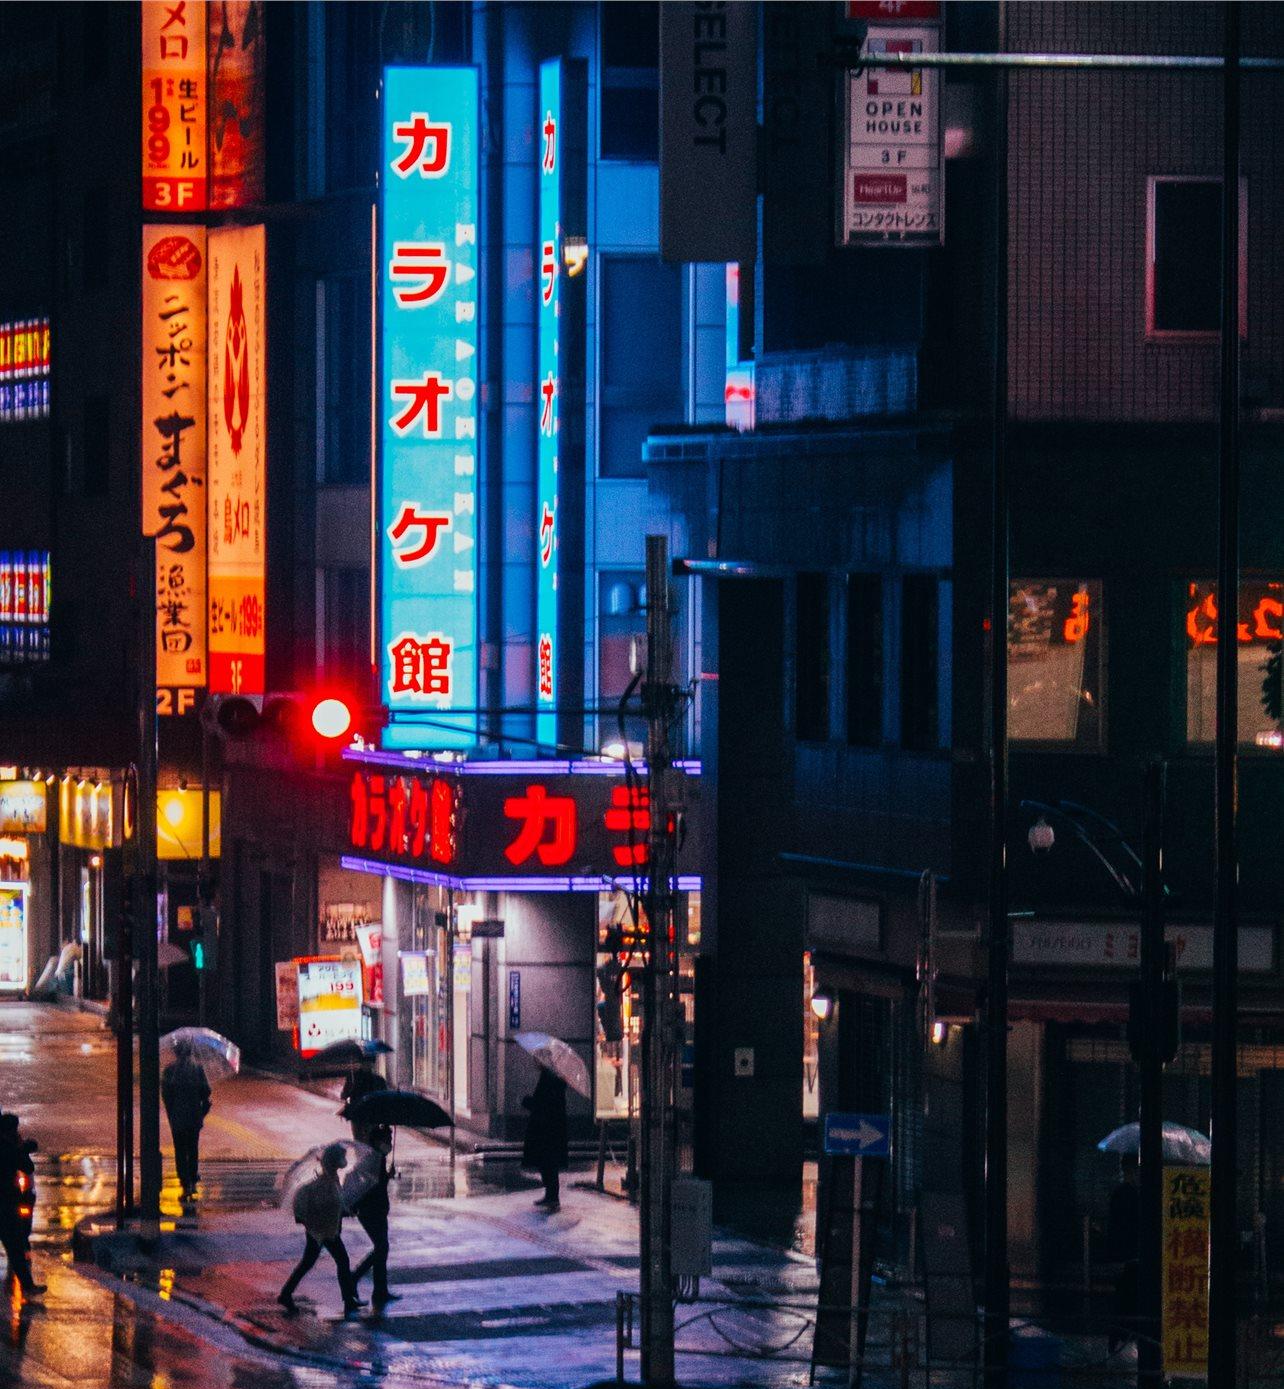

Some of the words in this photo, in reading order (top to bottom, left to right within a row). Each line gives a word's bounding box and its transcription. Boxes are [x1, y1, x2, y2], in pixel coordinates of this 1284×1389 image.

[148, 77, 171, 163] 199
[866, 101, 923, 117] OPEN
[178, 78, 200, 169] 生ビール
[866, 120, 923, 134] HOUSE
[154, 182, 194, 207] 3F
[389, 111, 452, 699] カラオケ館
[540, 111, 556, 699] カラオケ館
[156, 688, 196, 716] 2F
[328, 981, 355, 993] 199
